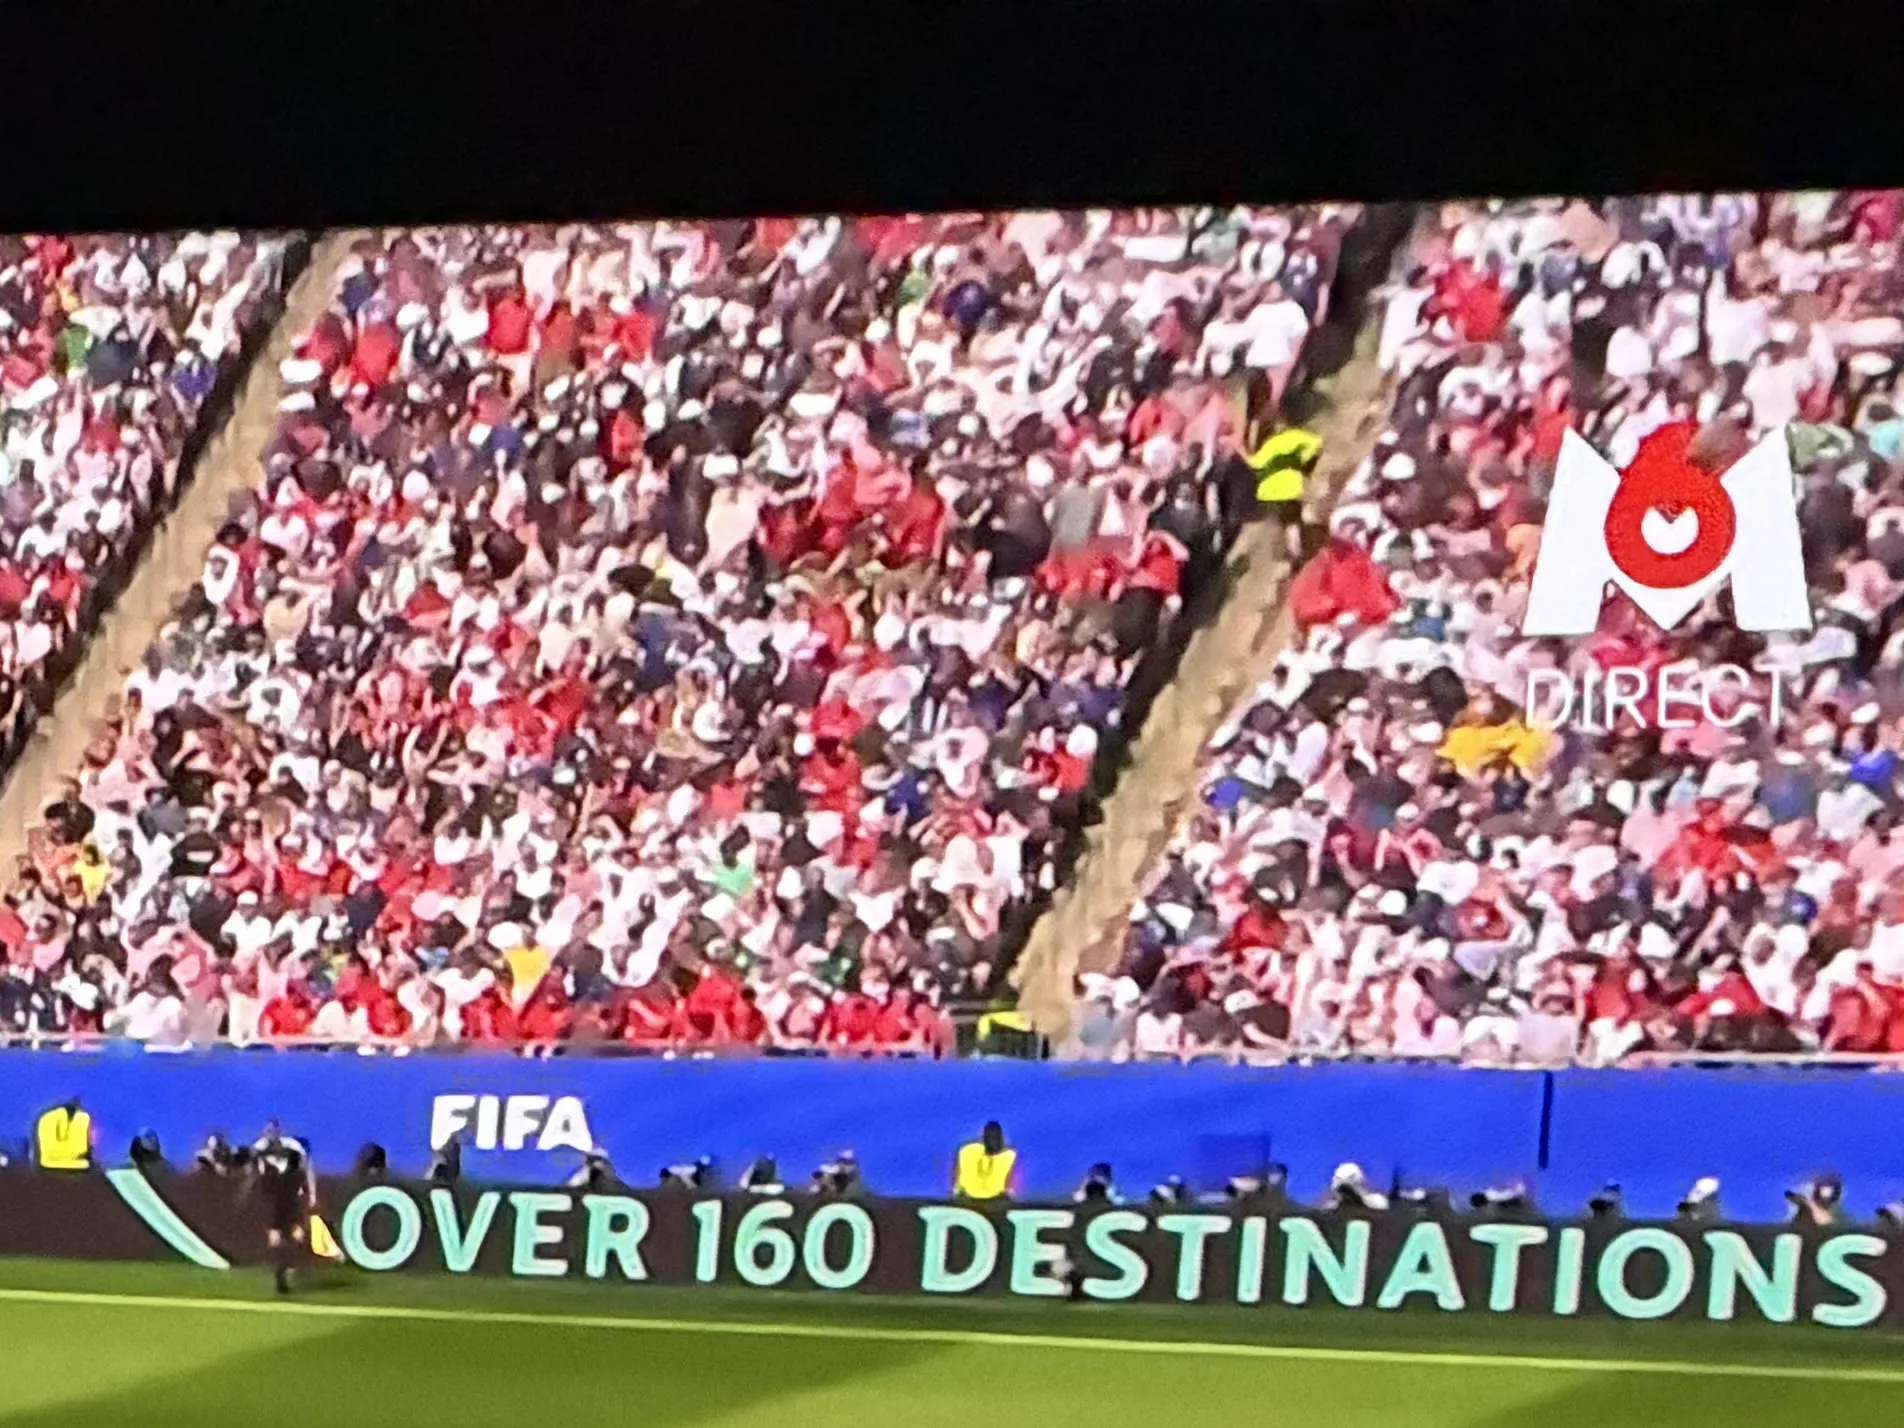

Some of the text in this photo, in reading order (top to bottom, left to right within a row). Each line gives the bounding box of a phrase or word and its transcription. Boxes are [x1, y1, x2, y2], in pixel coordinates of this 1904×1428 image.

[1525, 658, 1790, 731] DIRECT
[430, 1094, 593, 1153] FIFA
[342, 1185, 1887, 1328] OVER 160 DESTINATIONS
